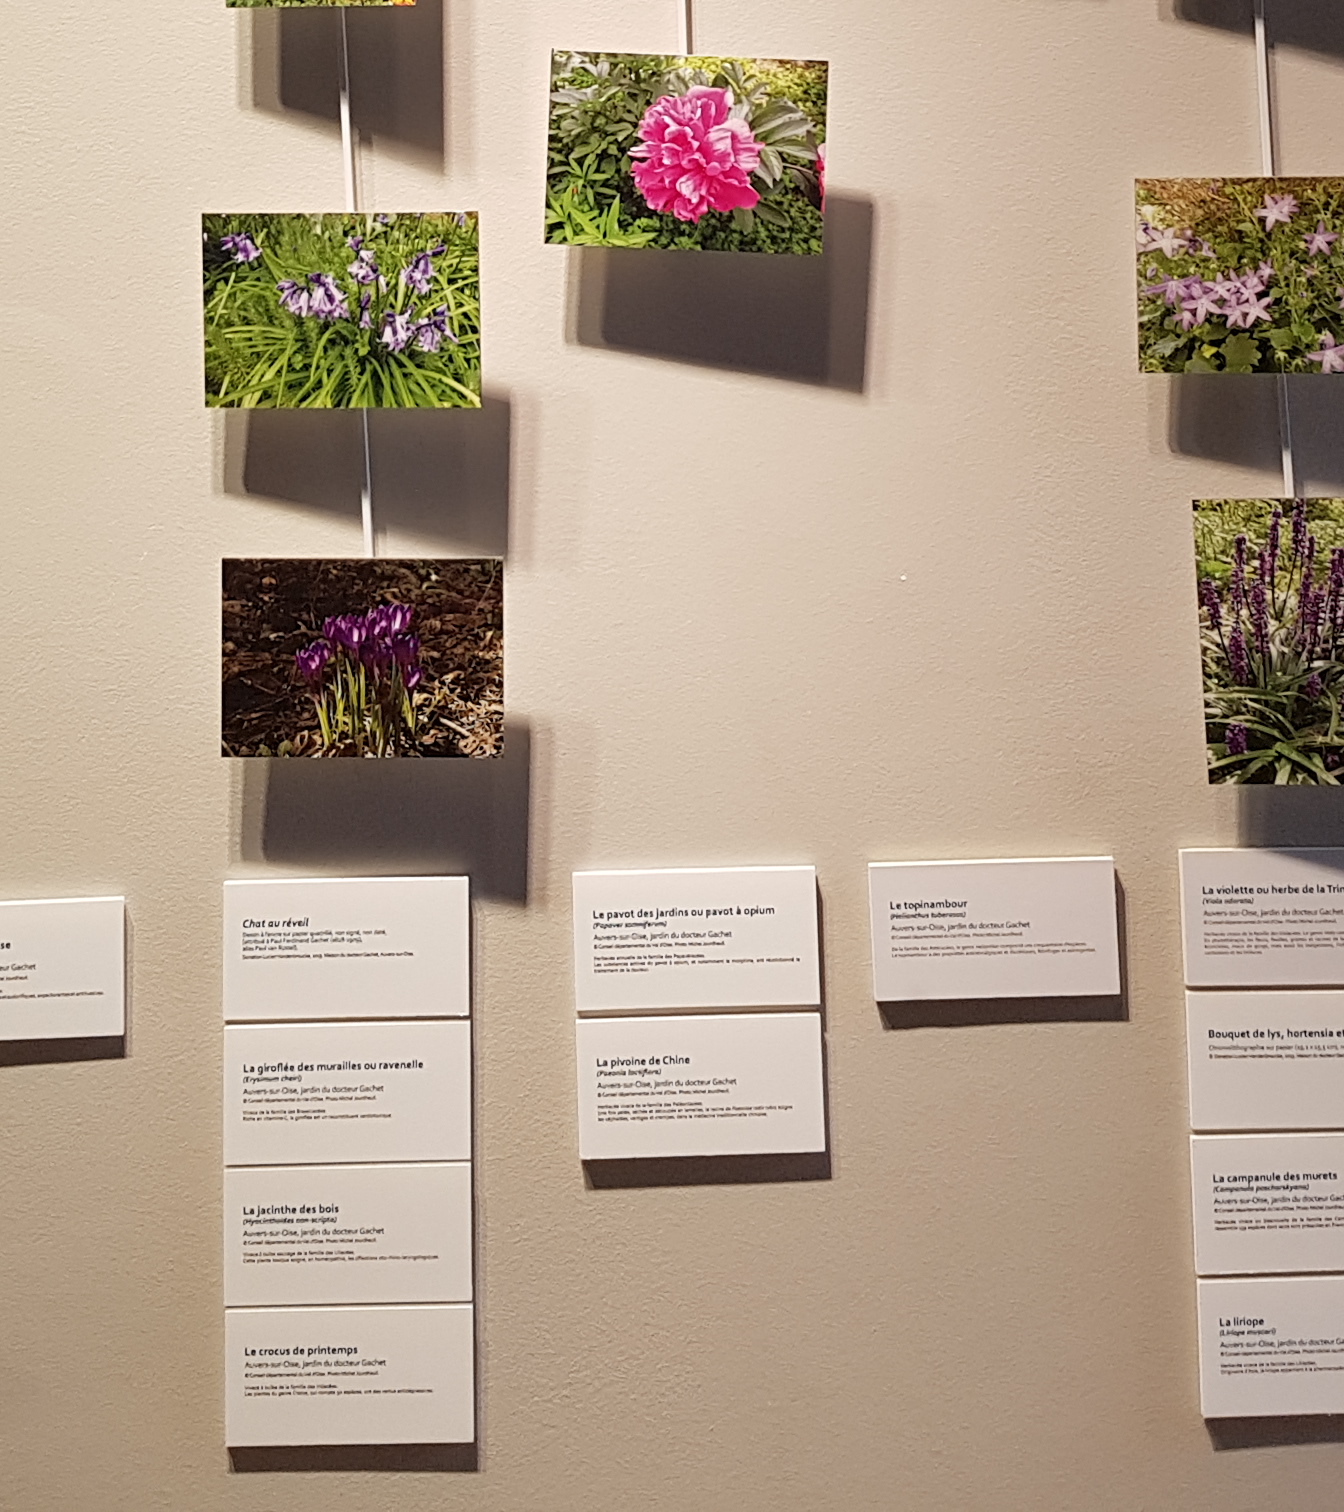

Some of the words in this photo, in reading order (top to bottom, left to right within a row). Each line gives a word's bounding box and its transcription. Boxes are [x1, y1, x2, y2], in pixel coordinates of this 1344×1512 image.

[1201, 886, 1214, 895] La
[1216, 885, 1254, 895] violette
[1271, 885, 1299, 894] herbe
[1301, 885, 1314, 894] de
[1316, 885, 1325, 894] la
[889, 901, 901, 910] Le
[903, 899, 967, 912] topinambour
[592, 910, 604, 920] Le
[606, 910, 634, 921] pavot
[636, 909, 653, 918] des
[656, 908, 688, 920] jardins
[690, 909, 703, 917] ou
[705, 907, 733, 918] pavot
[735, 906, 741, 916] à
[743, 906, 775, 917] opium
[242, 919, 265, 928] Chat
[281, 918, 308, 928] réveil
[1208, 1029, 1250, 1041] Bouquet
[1252, 1029, 1265, 1038] de
[1267, 1029, 1284, 1040] lys,
[1286, 1029, 1333, 1038] hortensia
[243, 1064, 255, 1073] La
[257, 1063, 294, 1075] giroflée
[297, 1062, 314, 1072] des
[316, 1061, 361, 1071] murailles
[378, 1060, 423, 1070] ravenelle
[596, 1058, 608, 1067] La
[610, 1057, 646, 1069] pivoine
[648, 1056, 660, 1066] de
[662, 1055, 690, 1065] Chine
[1212, 1174, 1224, 1183] La
[1226, 1173, 1281, 1185] campanule
[1283, 1172, 1300, 1182] des
[1302, 1172, 1337, 1181] murets
[242, 1206, 254, 1215] La
[257, 1206, 297, 1217] jacinthe
[299, 1205, 316, 1214] des
[318, 1205, 339, 1214] bois
[1219, 1318, 1231, 1327] La
[1233, 1317, 1264, 1328] liriope
[244, 1347, 256, 1356] Le
[258, 1348, 290, 1356] crocus
[292, 1346, 305, 1355] de
[307, 1345, 358, 1357] printemps
